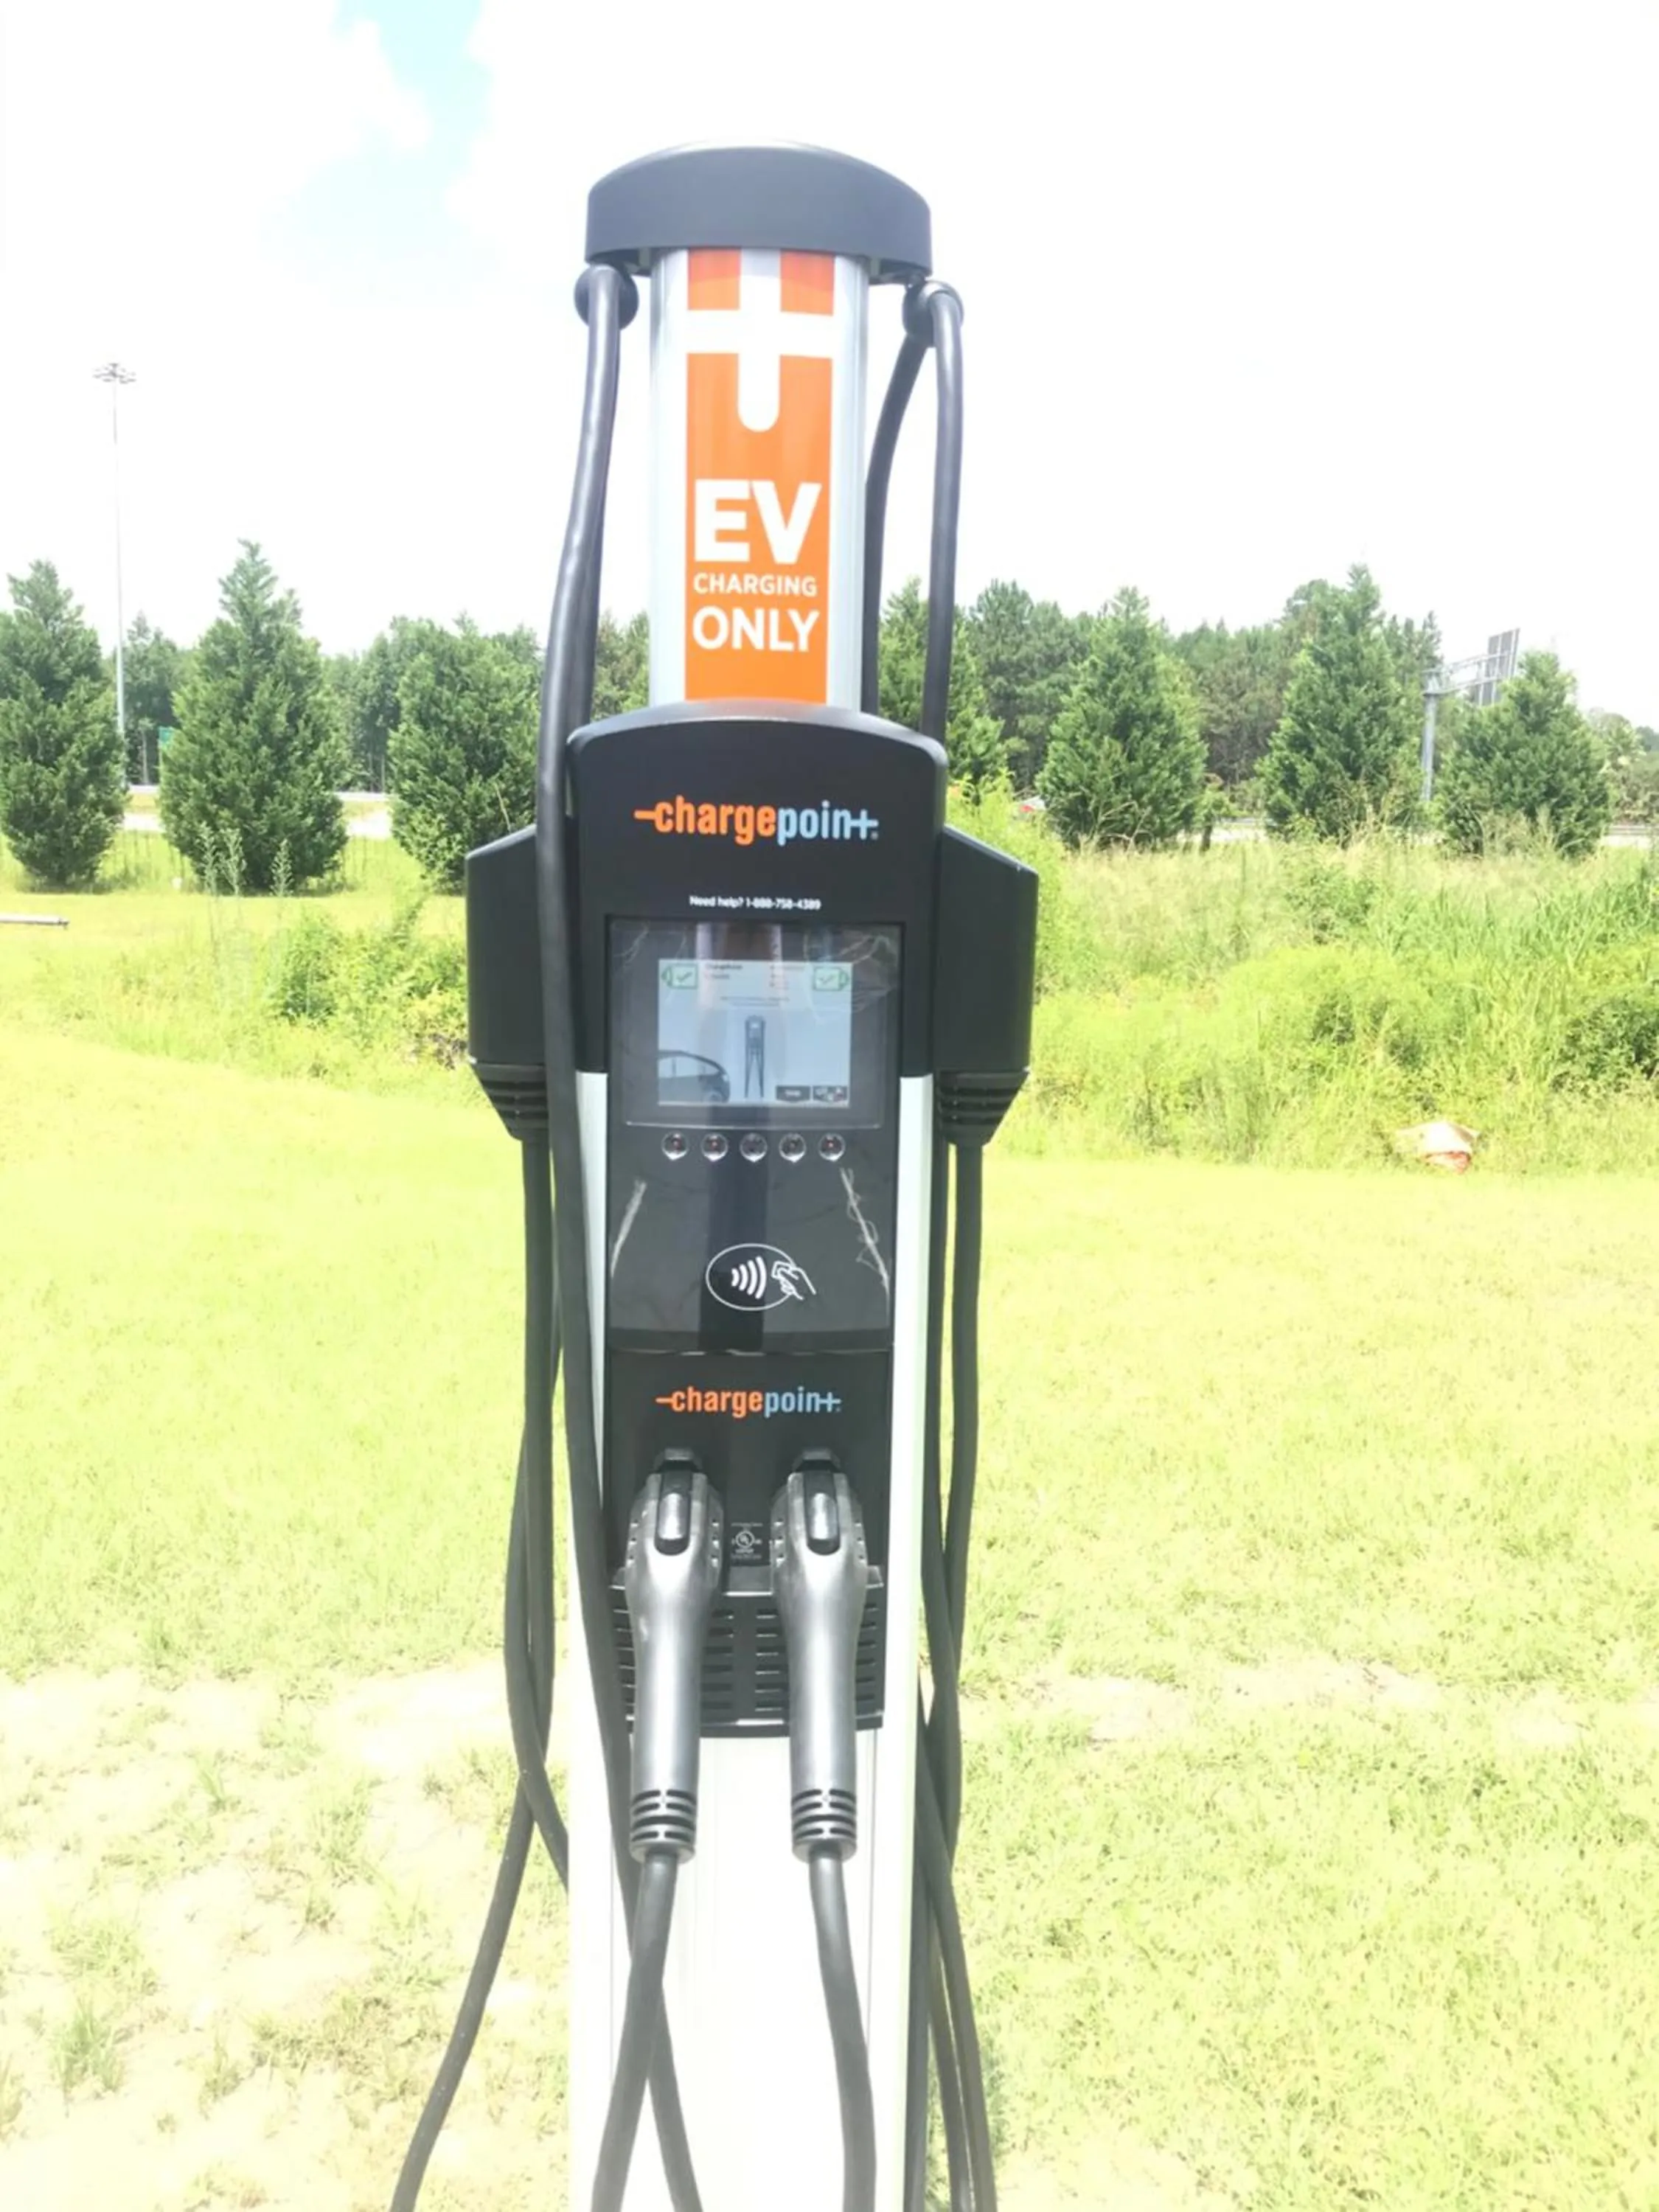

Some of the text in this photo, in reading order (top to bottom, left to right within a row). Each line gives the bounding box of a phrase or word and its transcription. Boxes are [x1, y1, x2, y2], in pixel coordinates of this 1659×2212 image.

[695, 479, 823, 565] EV
[693, 572, 818, 598] CHARGING
[692, 605, 821, 653] ONLY
[689, 895, 716, 908] Need
[717, 895, 744, 909] help?
